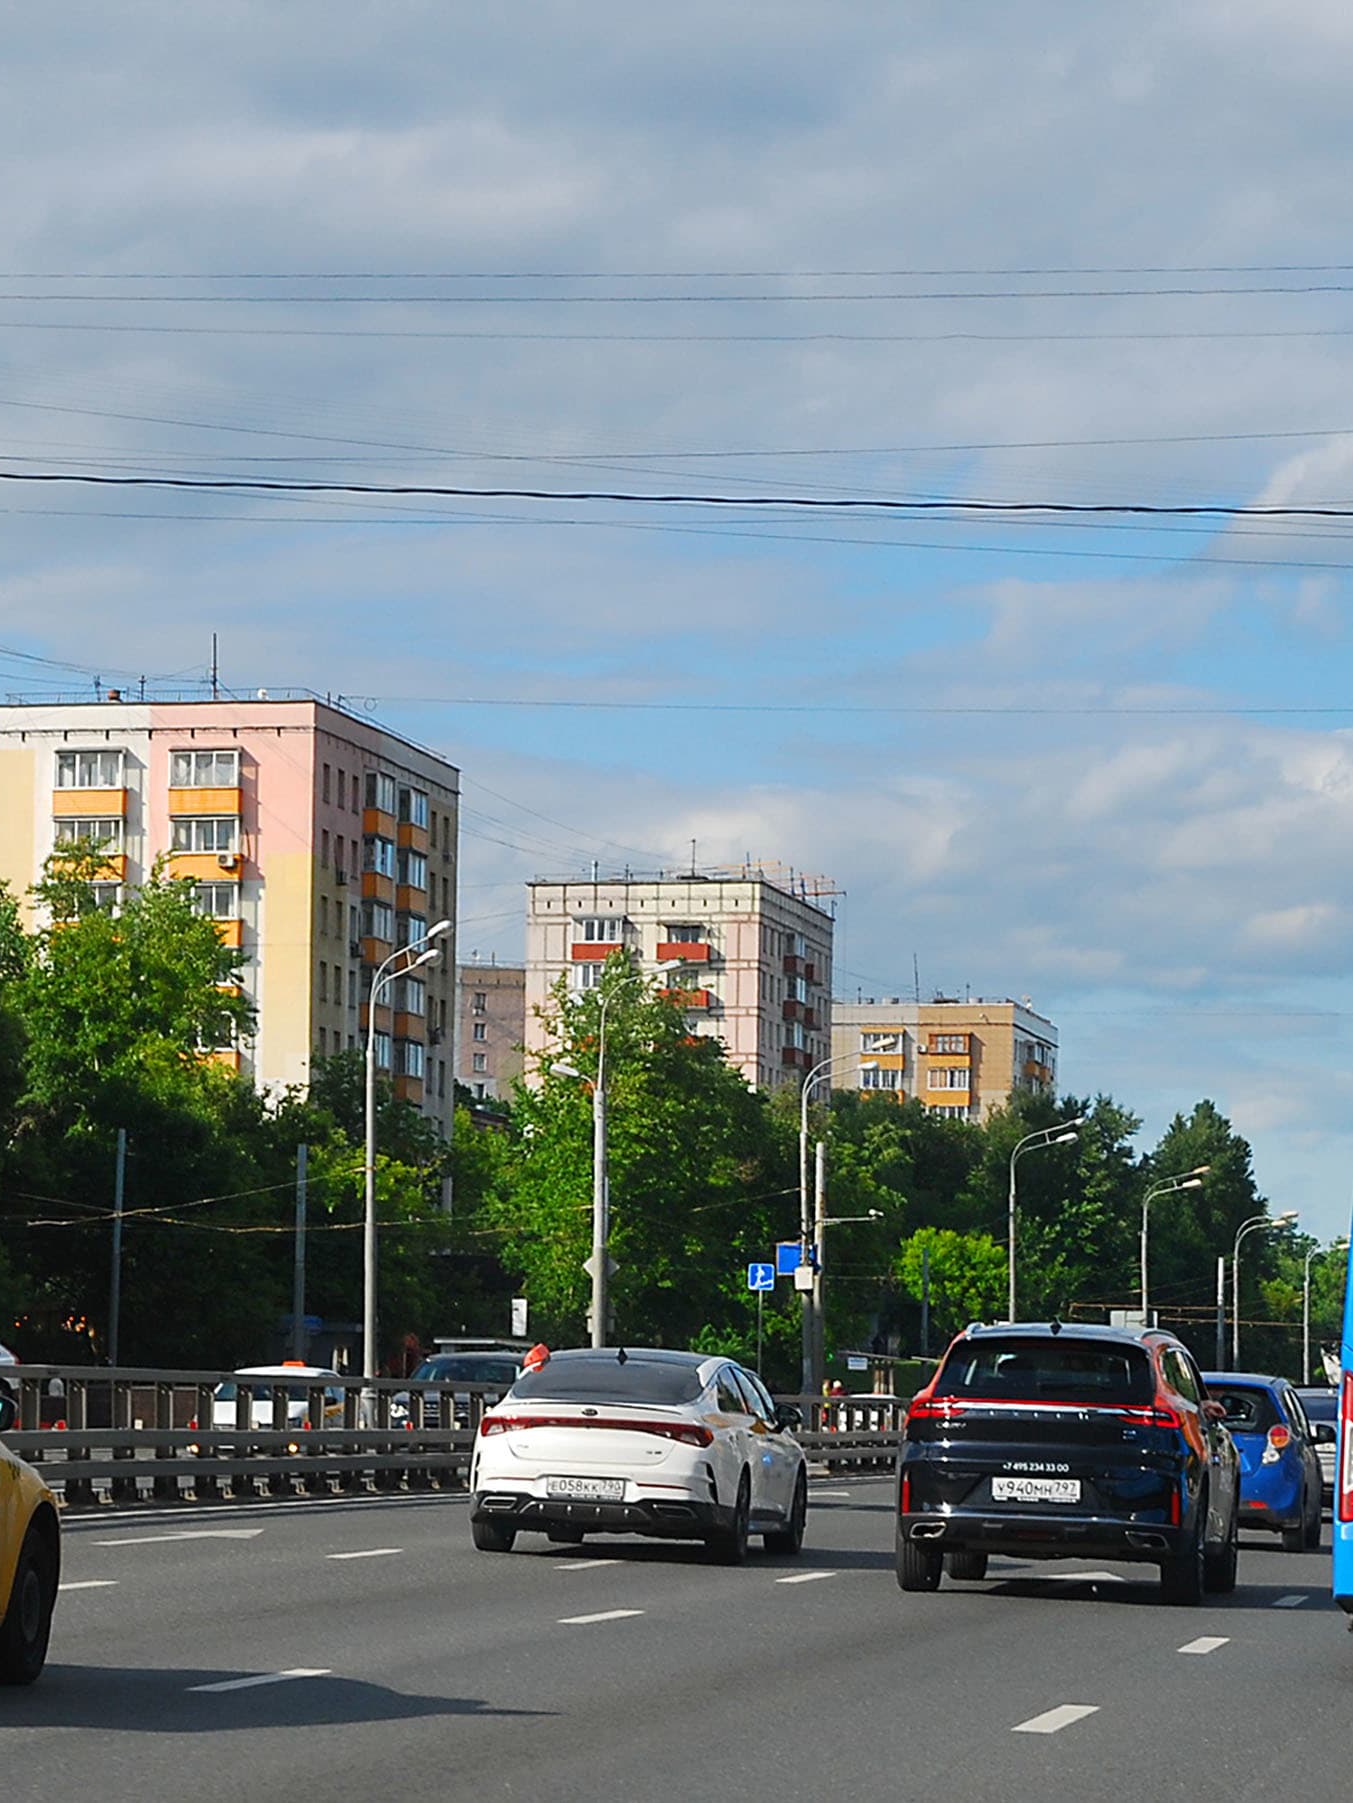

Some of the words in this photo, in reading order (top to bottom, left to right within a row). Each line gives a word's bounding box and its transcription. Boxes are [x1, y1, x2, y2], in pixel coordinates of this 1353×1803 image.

[1029, 1462, 1045, 1472] 234
[1046, 1463, 1056, 1472] 33
[1057, 1463, 1070, 1473] 00
[551, 1476, 598, 1493] Е058КК
[997, 1481, 1053, 1496] У940МН
[1054, 1481, 1077, 1496] 797
